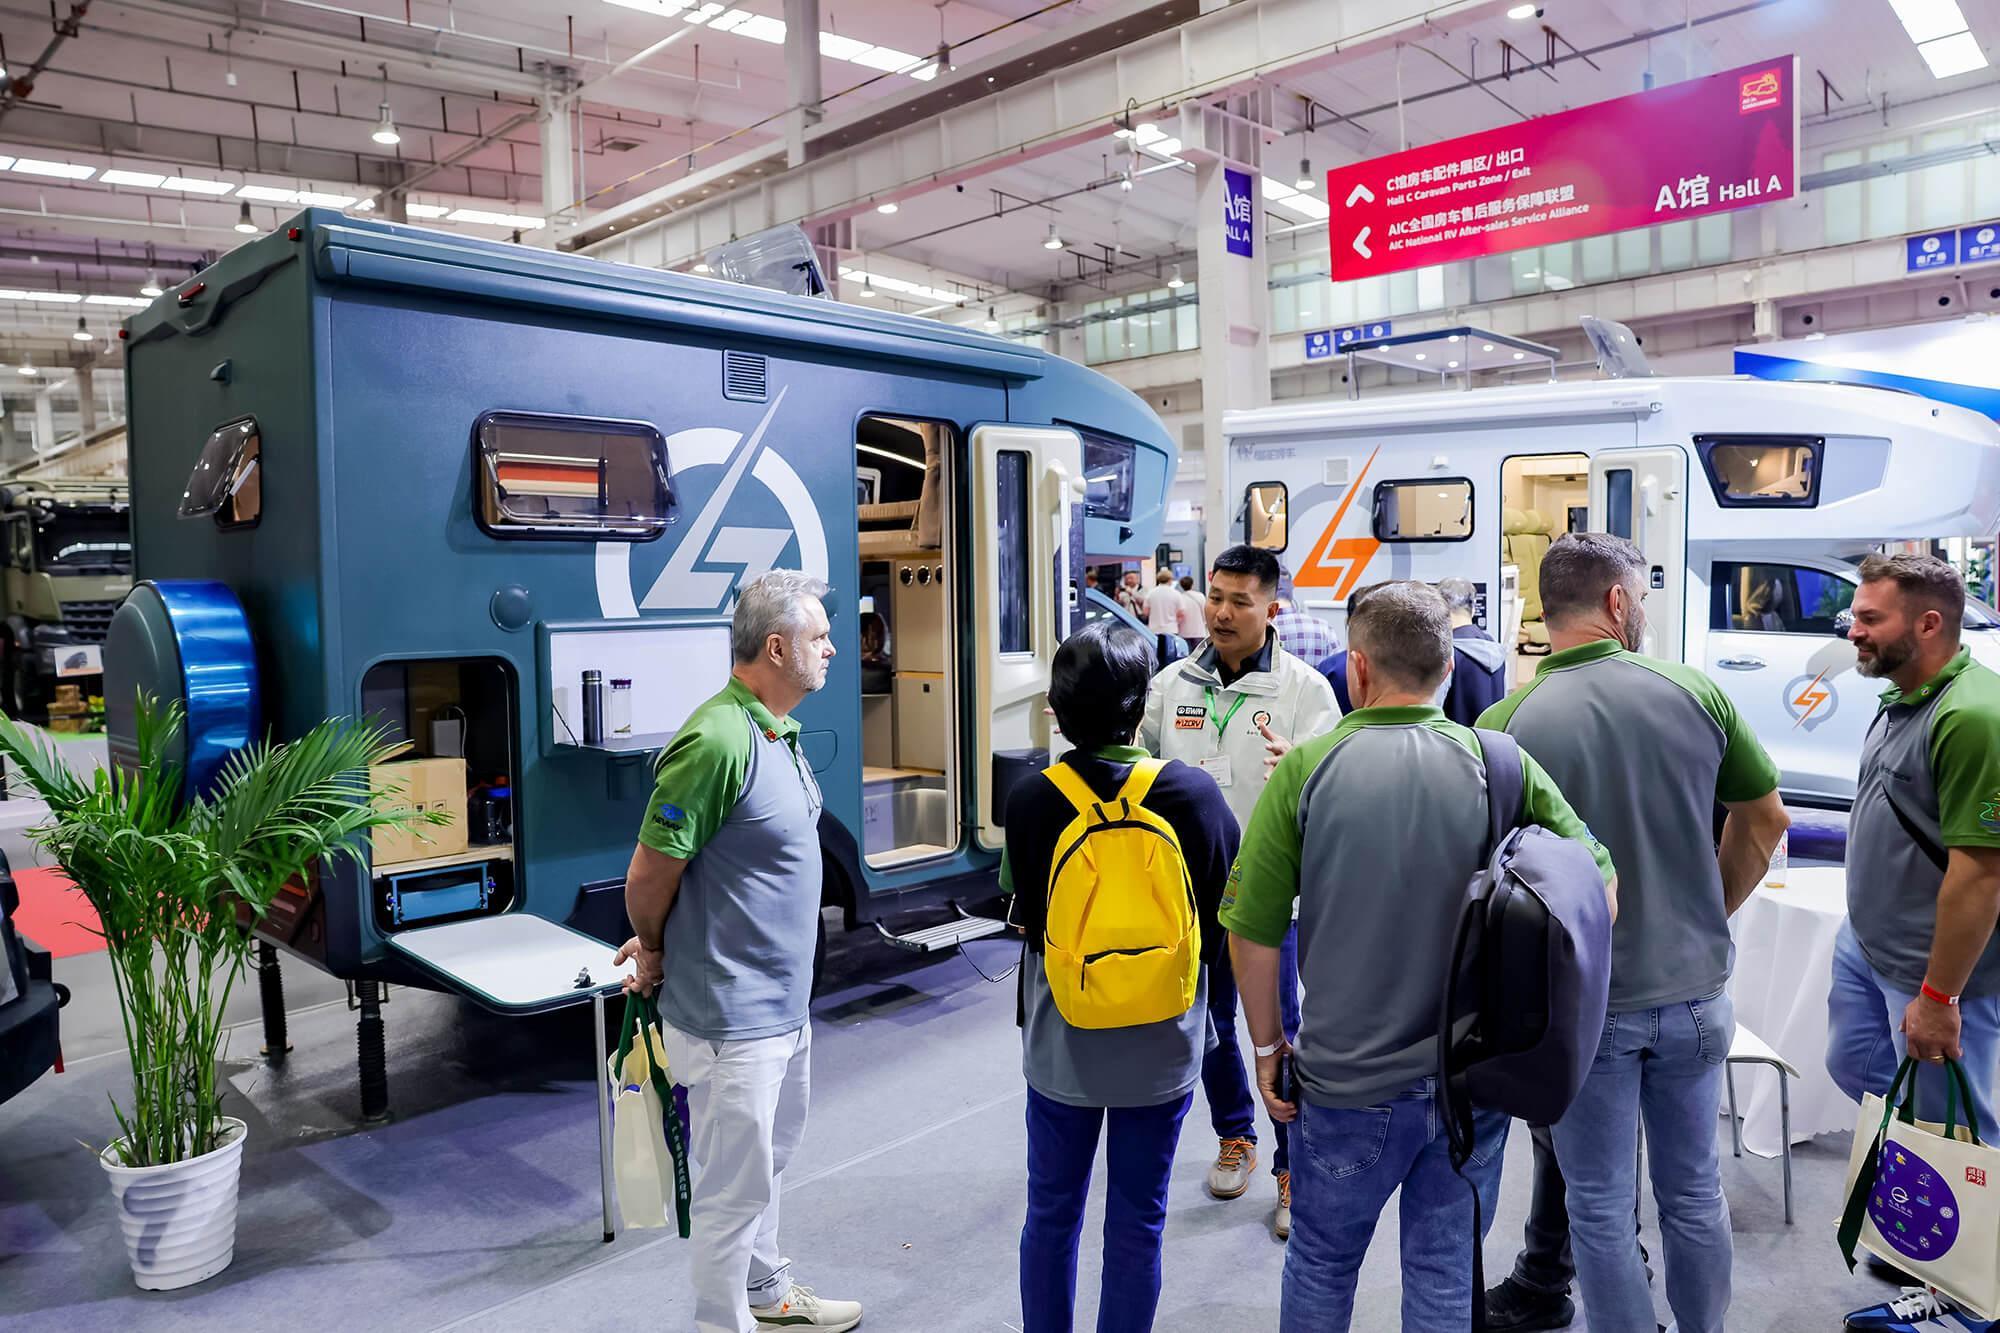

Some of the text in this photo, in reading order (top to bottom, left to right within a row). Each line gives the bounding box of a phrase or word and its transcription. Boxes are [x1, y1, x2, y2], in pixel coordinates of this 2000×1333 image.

[1496, 147, 1524, 167] 出口
[1387, 195, 1405, 206] Hall
[1406, 193, 1413, 202] C
[1414, 185, 1451, 200] Caravan
[1452, 179, 1477, 191] Parts
[1479, 174, 1503, 186] Zone
[1512, 166, 1531, 178] Exit
[1655, 174, 1782, 212] A馆 Hall A
[1388, 184, 1575, 236] AIC全国房车售后服务保障联盟
[1389, 204, 1590, 251] AIC National RV After-sales Service Alliance
[1243, 229, 1250, 243] A
